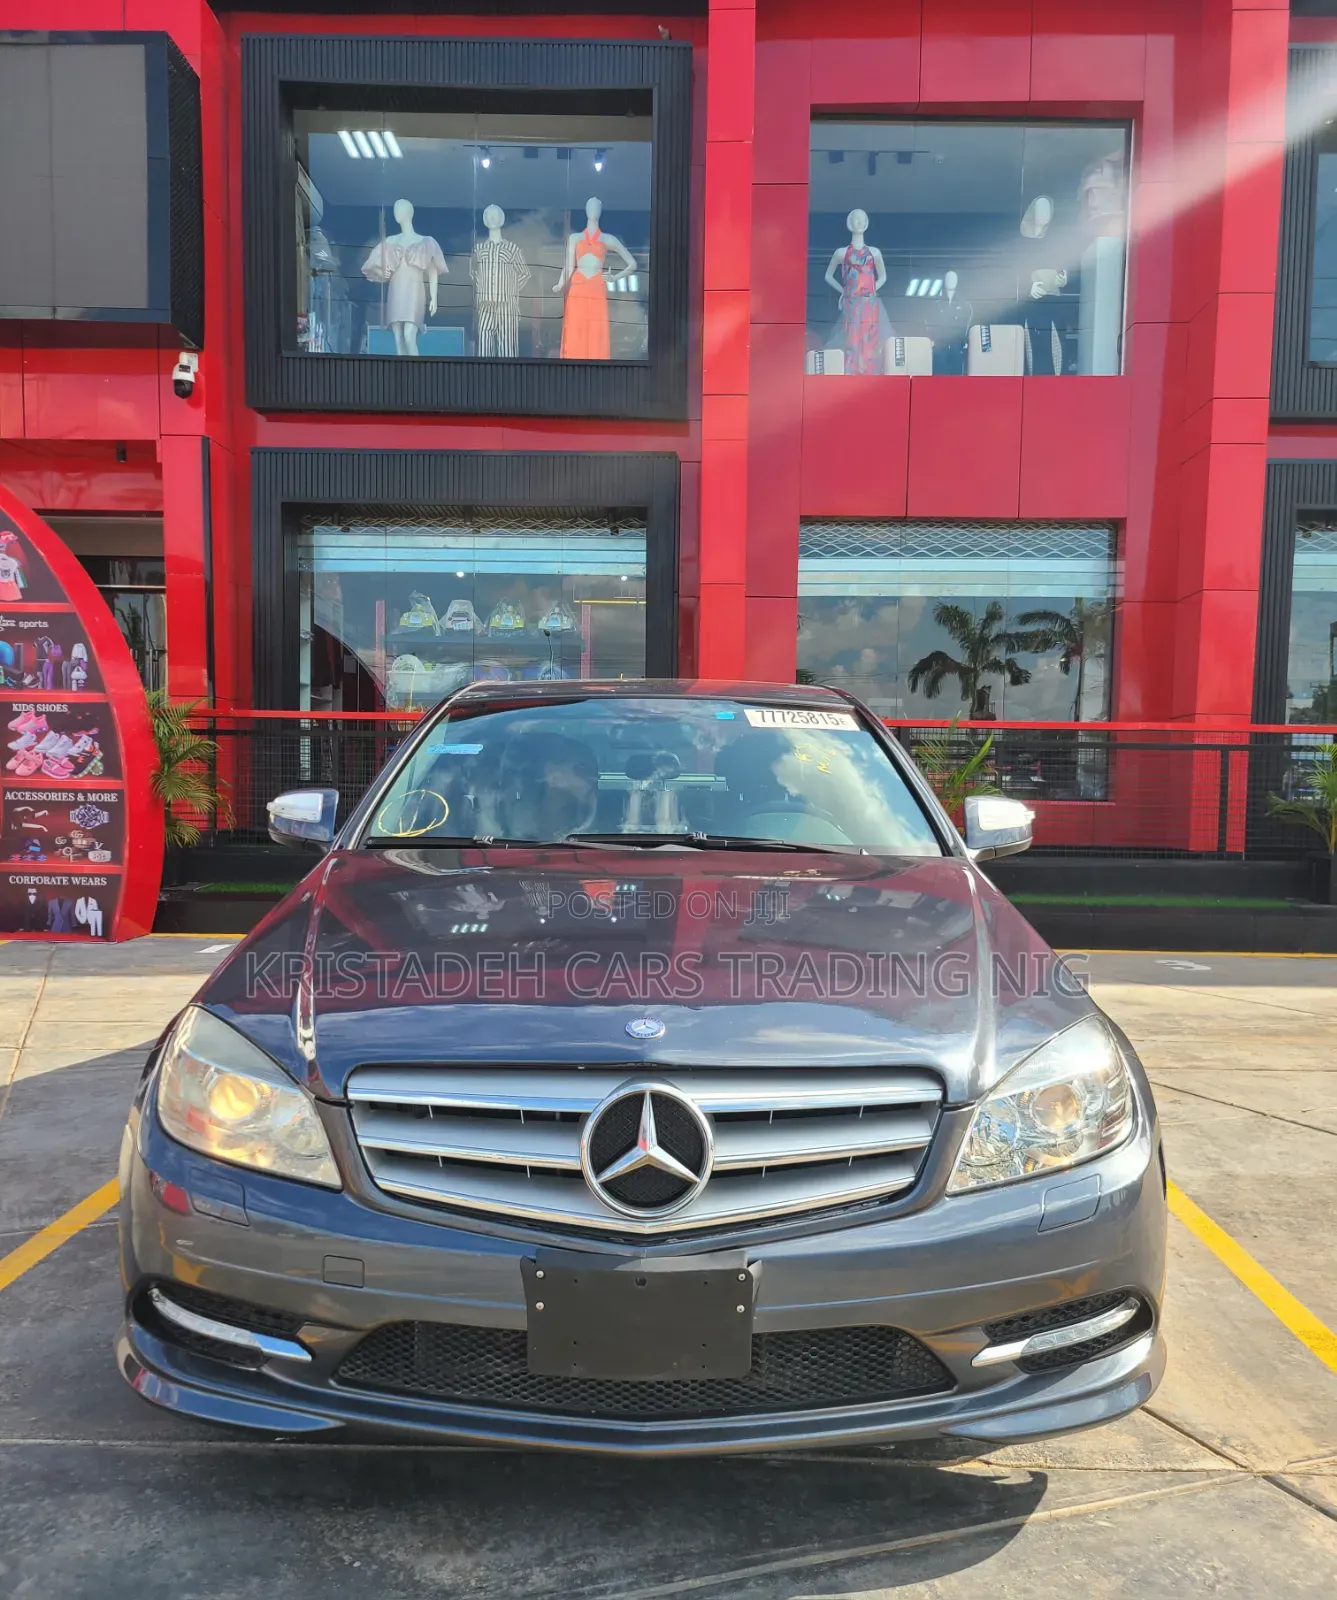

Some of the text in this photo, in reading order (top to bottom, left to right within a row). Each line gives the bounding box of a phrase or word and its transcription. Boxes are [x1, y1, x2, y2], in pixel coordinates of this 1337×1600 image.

[19, 620, 49, 629] sports
[12, 703, 69, 713] KIDS SHOES
[5, 791, 118, 802] ACCESSORIES & MORE
[9, 875, 108, 886] CORPORATE WEARS
